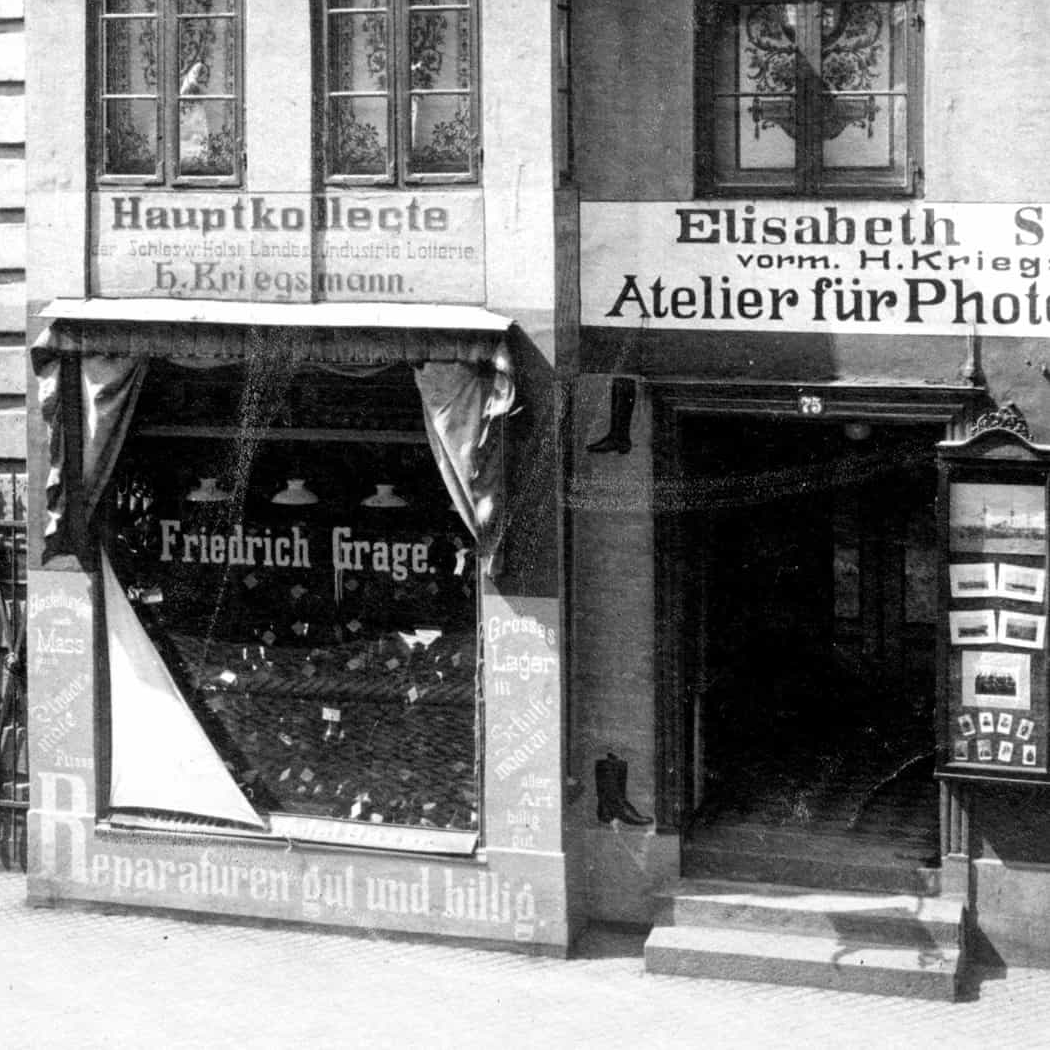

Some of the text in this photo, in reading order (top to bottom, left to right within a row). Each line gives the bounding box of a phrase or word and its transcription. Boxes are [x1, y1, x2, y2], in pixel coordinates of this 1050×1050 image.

[676, 205, 961, 246] Elisabeth
[737, 253, 841, 270] vorm.
[605, 275, 1050, 326] Atelier für Phot
[800, 396, 822, 414] 75
[160, 519, 437, 581] Friedrich Grage.
[488, 616, 556, 645] Grosses
[491, 644, 556, 680] Lager
[366, 865, 431, 917] und
